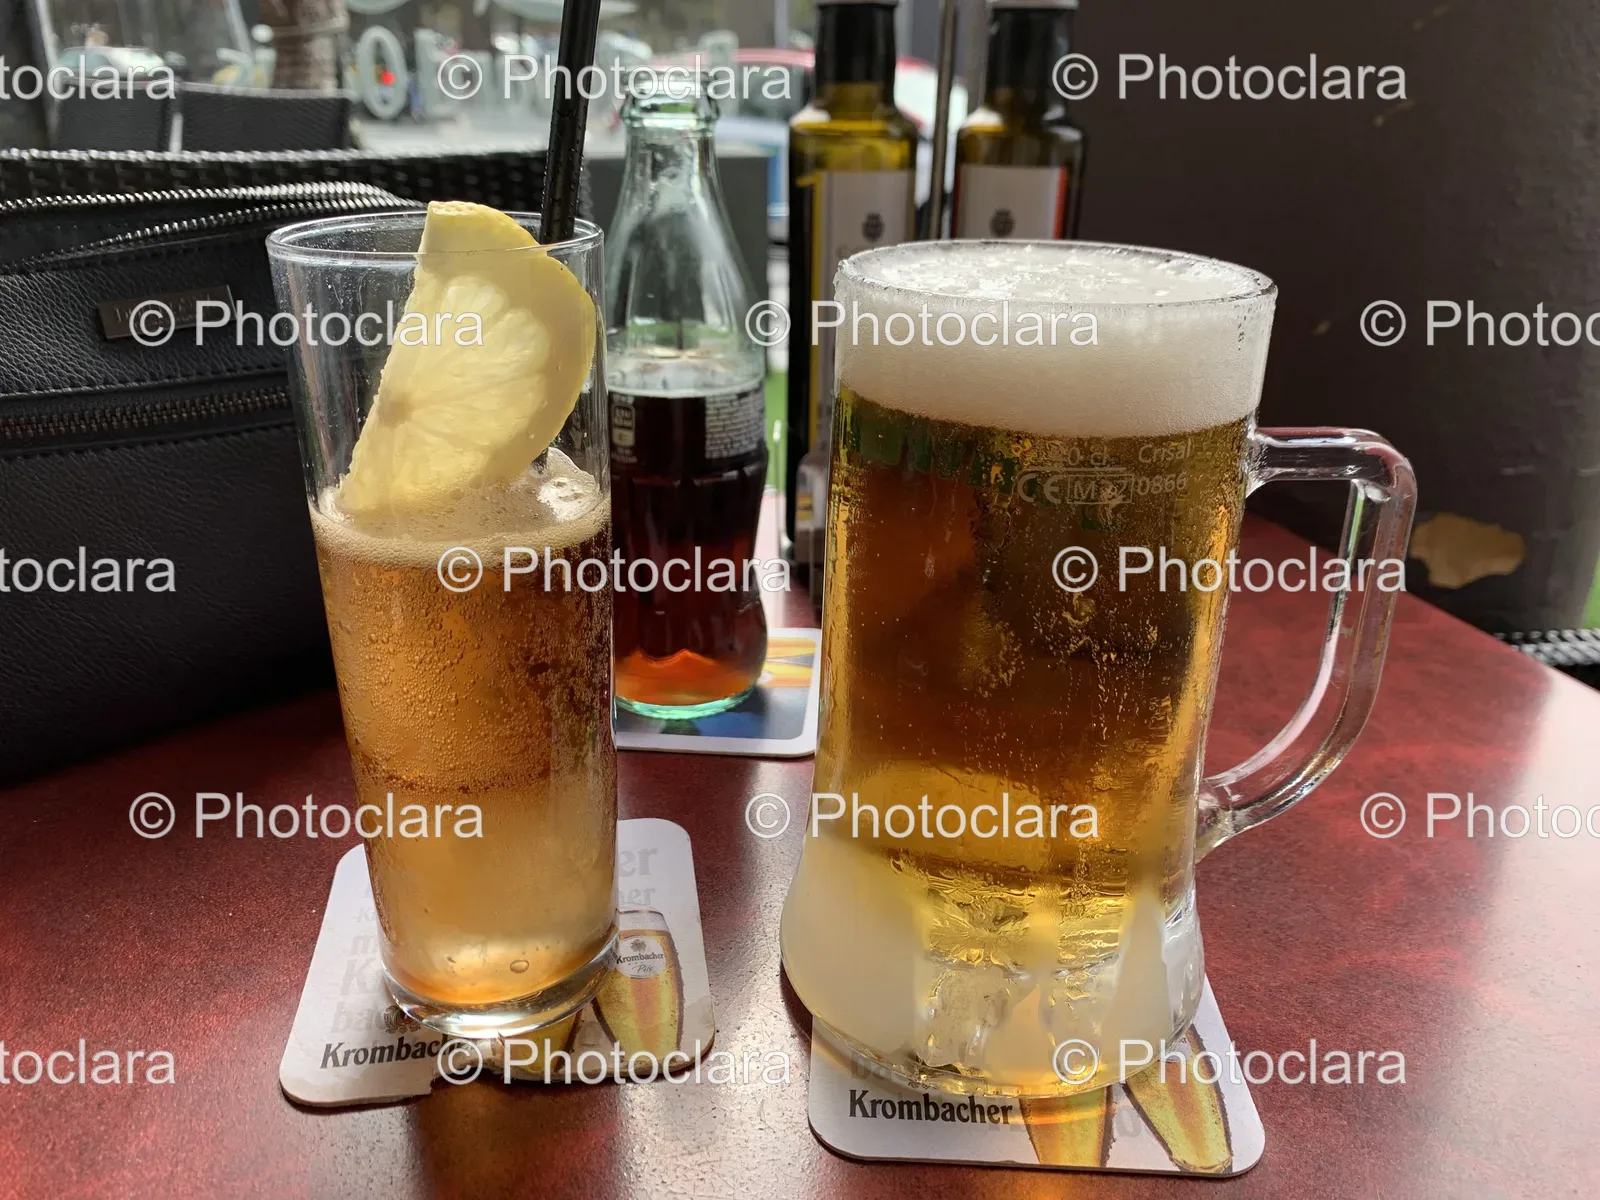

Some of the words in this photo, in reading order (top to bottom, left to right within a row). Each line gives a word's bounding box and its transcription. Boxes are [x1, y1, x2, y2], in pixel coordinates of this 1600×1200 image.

[1138, 437, 1192, 464] Crisal
[1136, 470, 1188, 496] 0866
[616, 951, 664, 965] Krombacher
[320, 1033, 470, 1069] Krombach
[849, 1088, 1014, 1126] Krombacher
